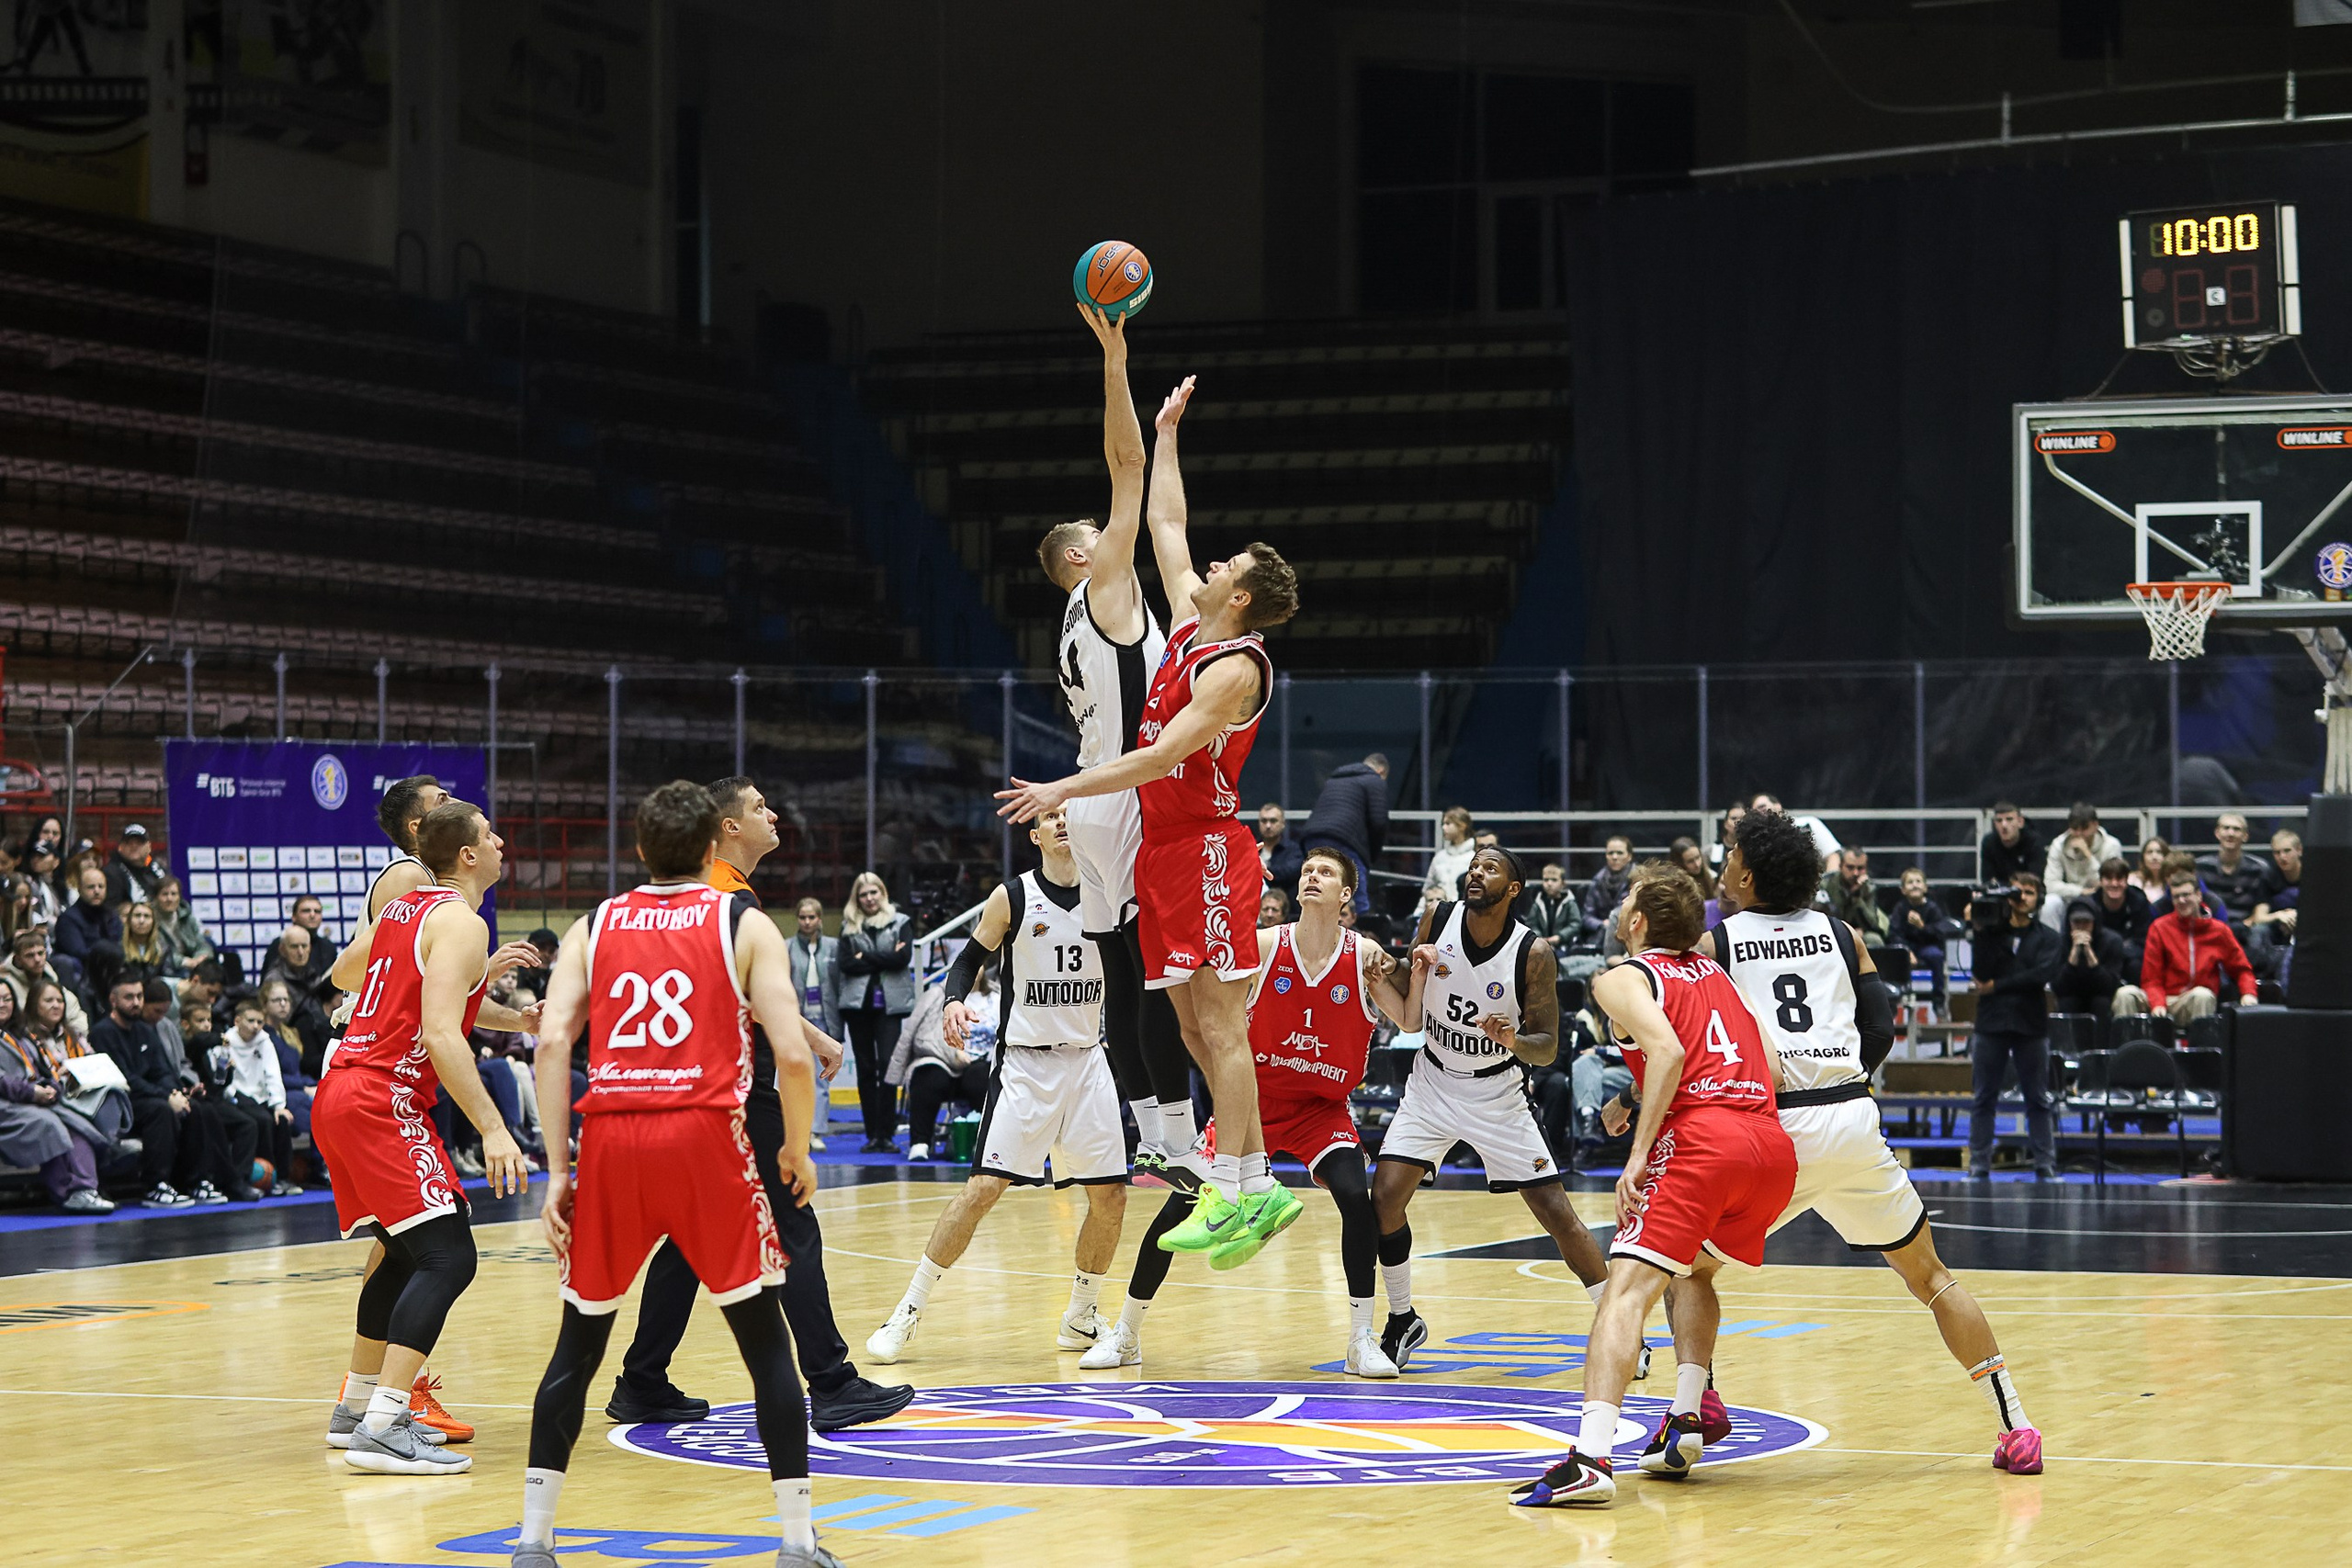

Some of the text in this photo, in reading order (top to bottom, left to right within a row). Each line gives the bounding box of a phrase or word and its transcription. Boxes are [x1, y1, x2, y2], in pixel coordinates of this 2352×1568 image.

[2163, 214, 2259, 256] 10:00
[2041, 435, 2098, 450] WINLINE
[2284, 431, 2343, 446] WINLINE
[607, 904, 711, 931] PLATUNOV
[1054, 944, 1083, 973] 13
[1734, 934, 1833, 963] EDWARDS
[1023, 977, 1102, 1007] AVTODOR
[1771, 973, 1814, 1033] 8
[607, 968, 694, 1049] 28
[1303, 1008, 1313, 1028] 1
[1446, 993, 1479, 1028] 52
[1706, 1009, 1744, 1066] 4
